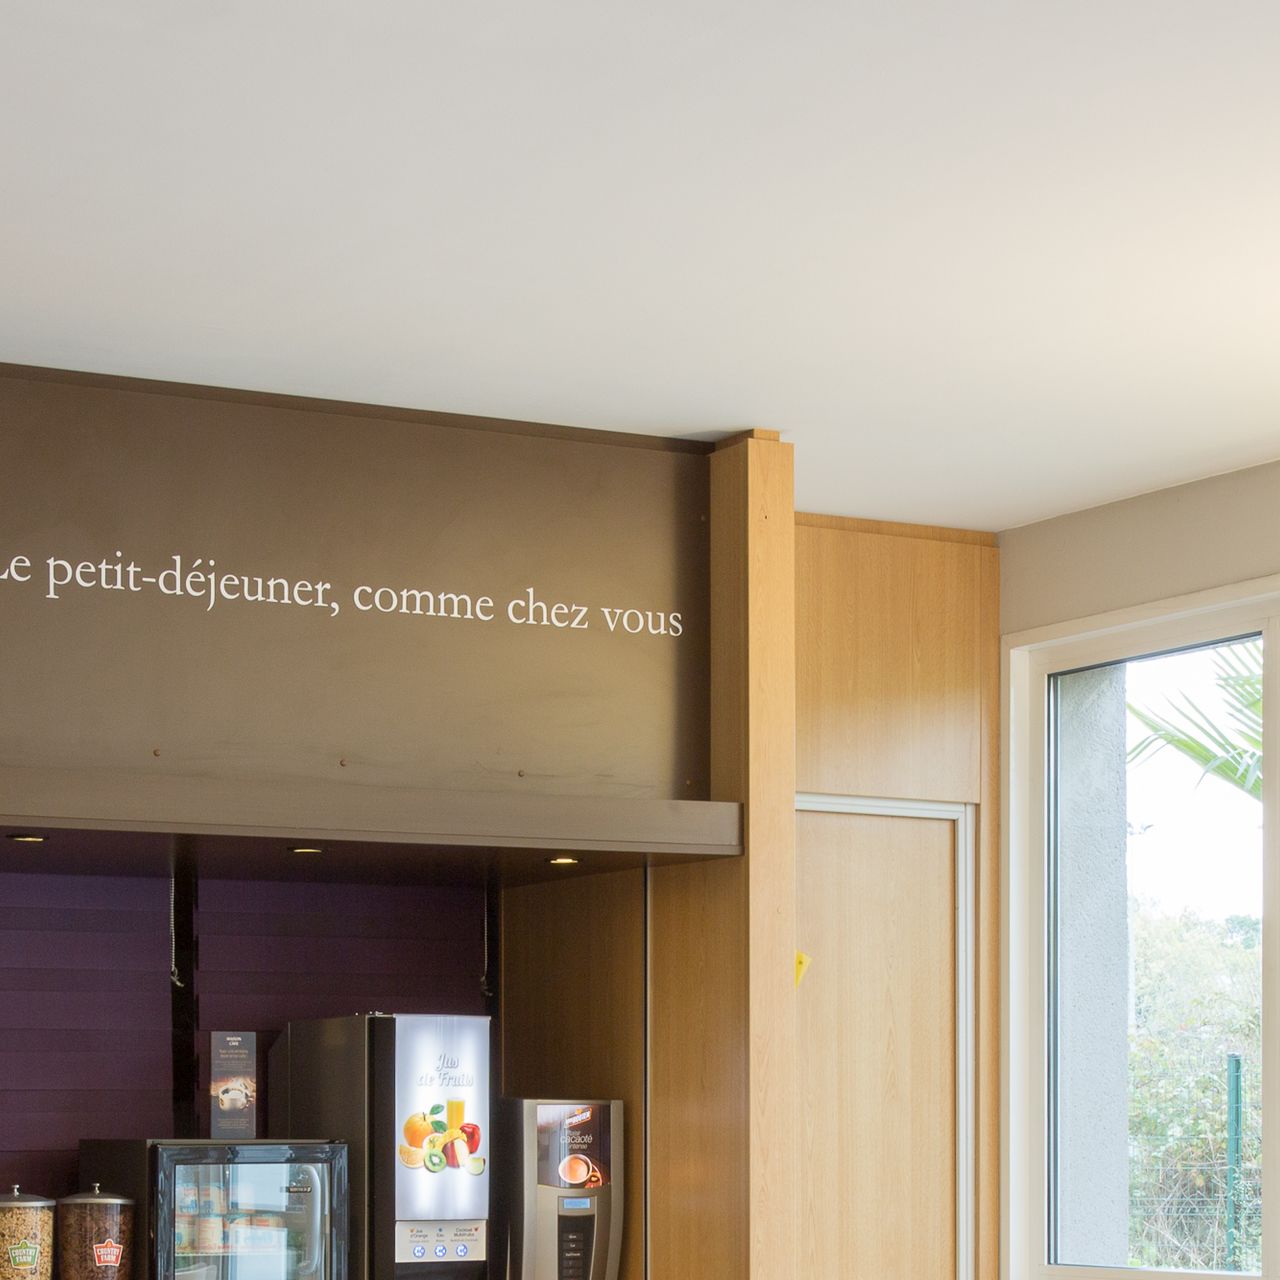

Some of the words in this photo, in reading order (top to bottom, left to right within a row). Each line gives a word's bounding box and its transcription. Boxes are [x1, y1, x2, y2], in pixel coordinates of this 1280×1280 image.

[45, 550, 340, 617] petit-déjeuner,
[353, 585, 494, 621] comme
[507, 587, 589, 629] chez
[600, 607, 683, 637] vous
[435, 1053, 460, 1072] Jus
[439, 1071, 474, 1087] Fruits
[12, 1248, 35, 1257] COUNTRY
[97, 1248, 120, 1256] COUNTRY
